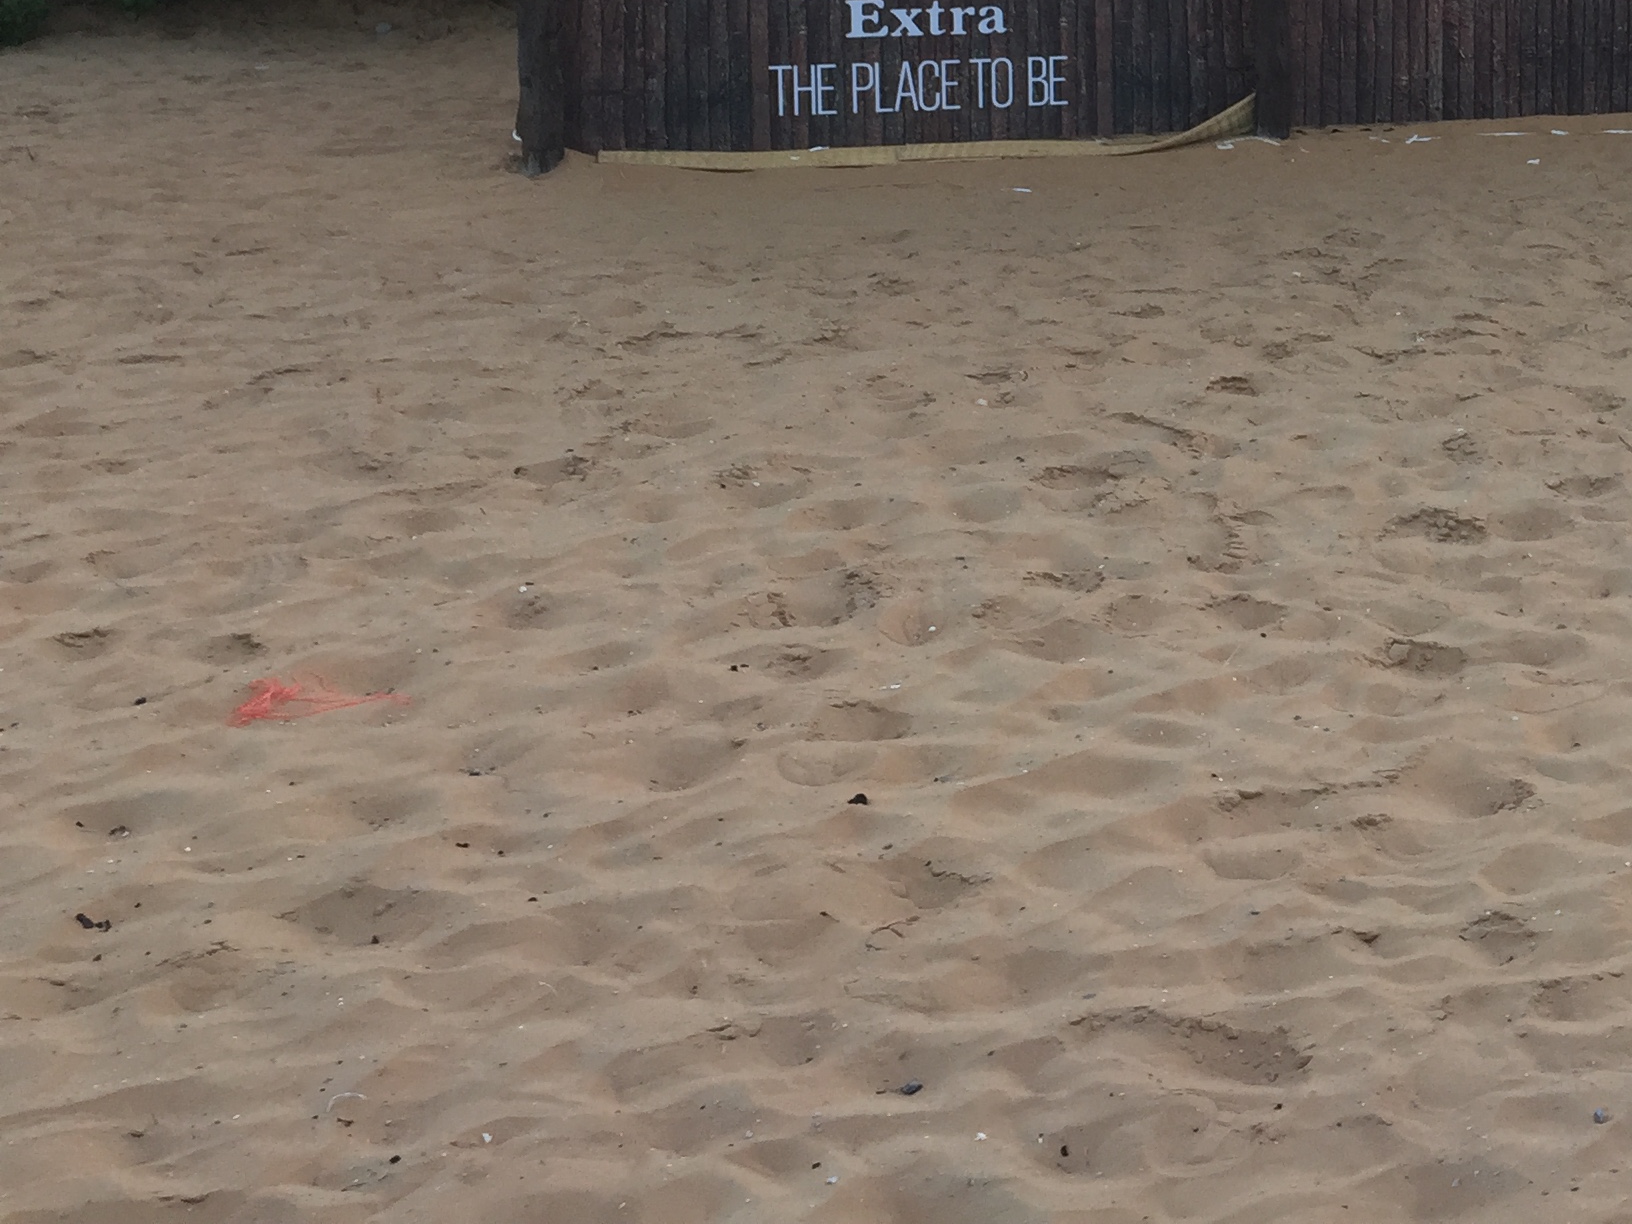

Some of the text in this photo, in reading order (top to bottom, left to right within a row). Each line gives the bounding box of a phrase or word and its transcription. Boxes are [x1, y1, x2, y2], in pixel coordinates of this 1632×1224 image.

[768, 55, 1069, 117] THE PLACE TO BE
